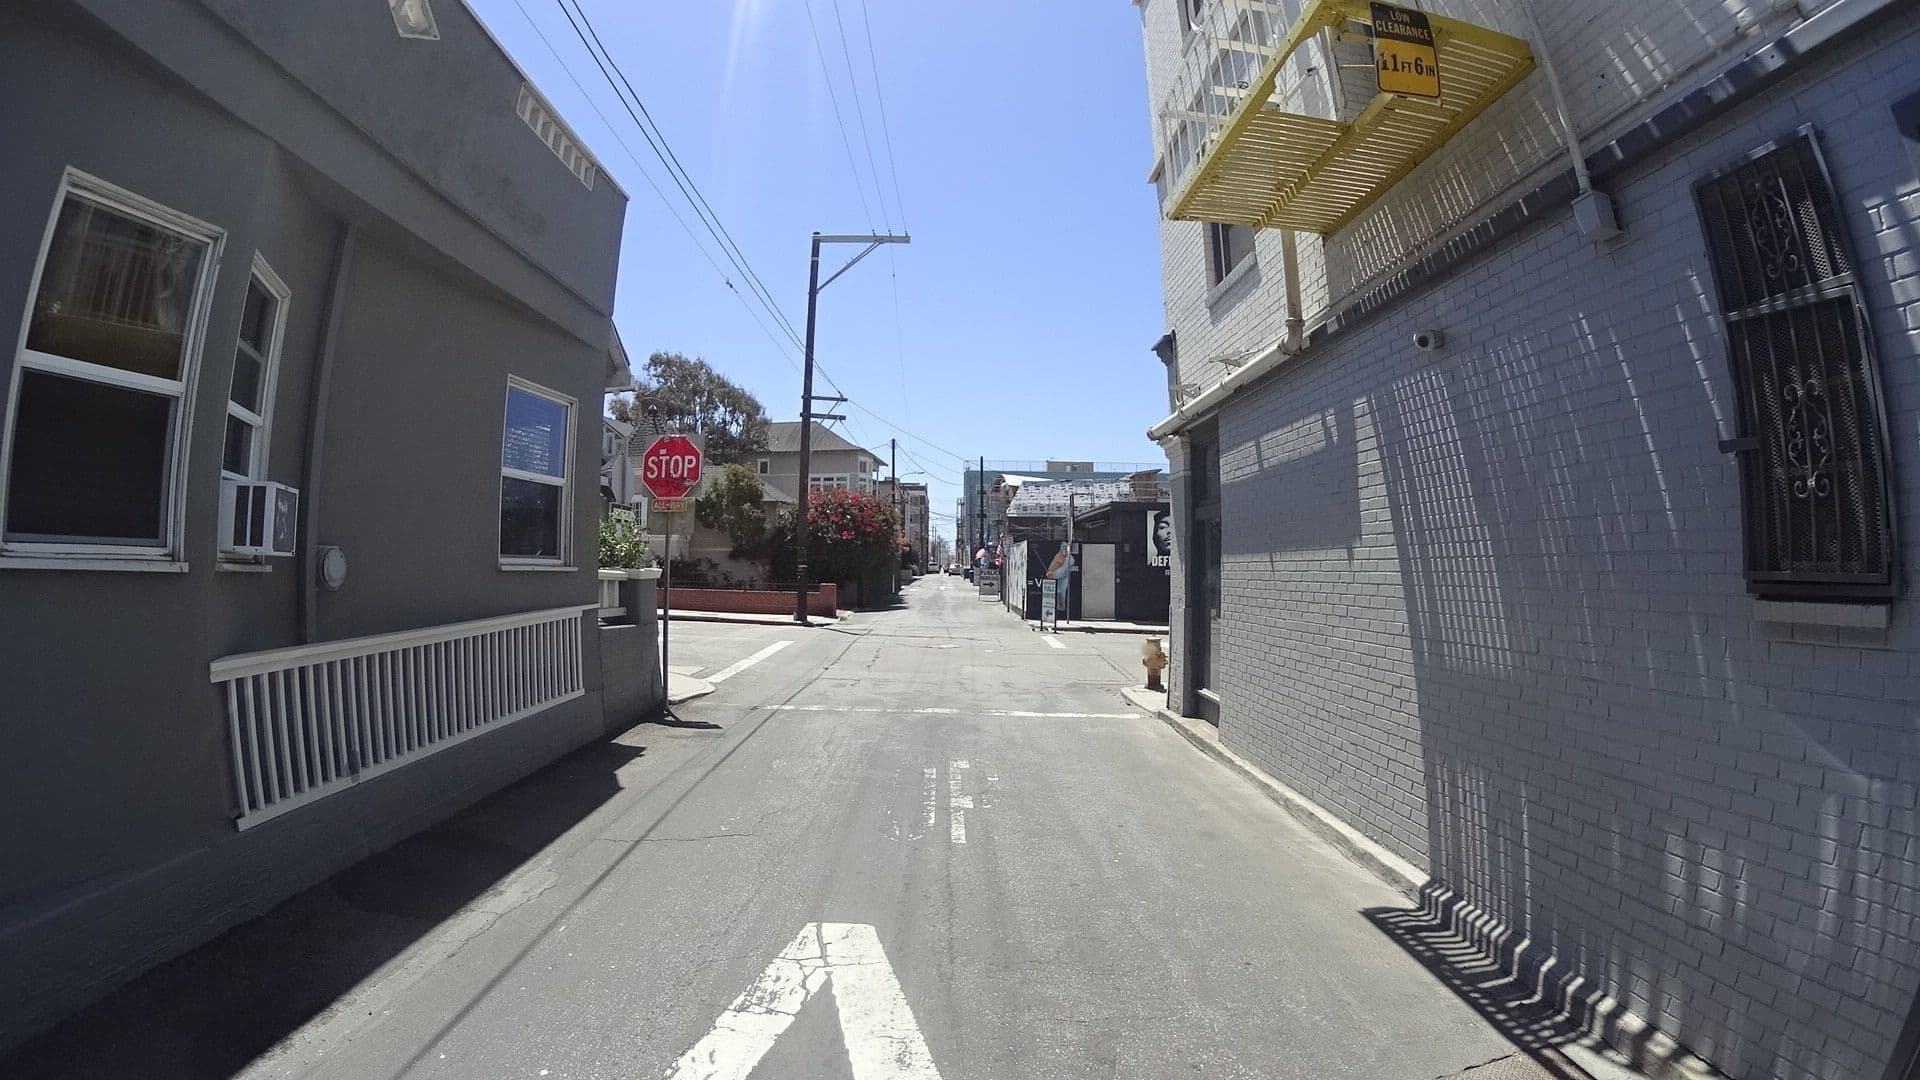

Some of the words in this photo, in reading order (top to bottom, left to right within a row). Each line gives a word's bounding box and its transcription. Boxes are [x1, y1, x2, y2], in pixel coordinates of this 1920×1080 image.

[1390, 9, 1410, 23] LOW
[1376, 20, 1431, 40] CLEARANCE
[646, 454, 697, 479] STOP
[1152, 555, 1171, 567] DEF
